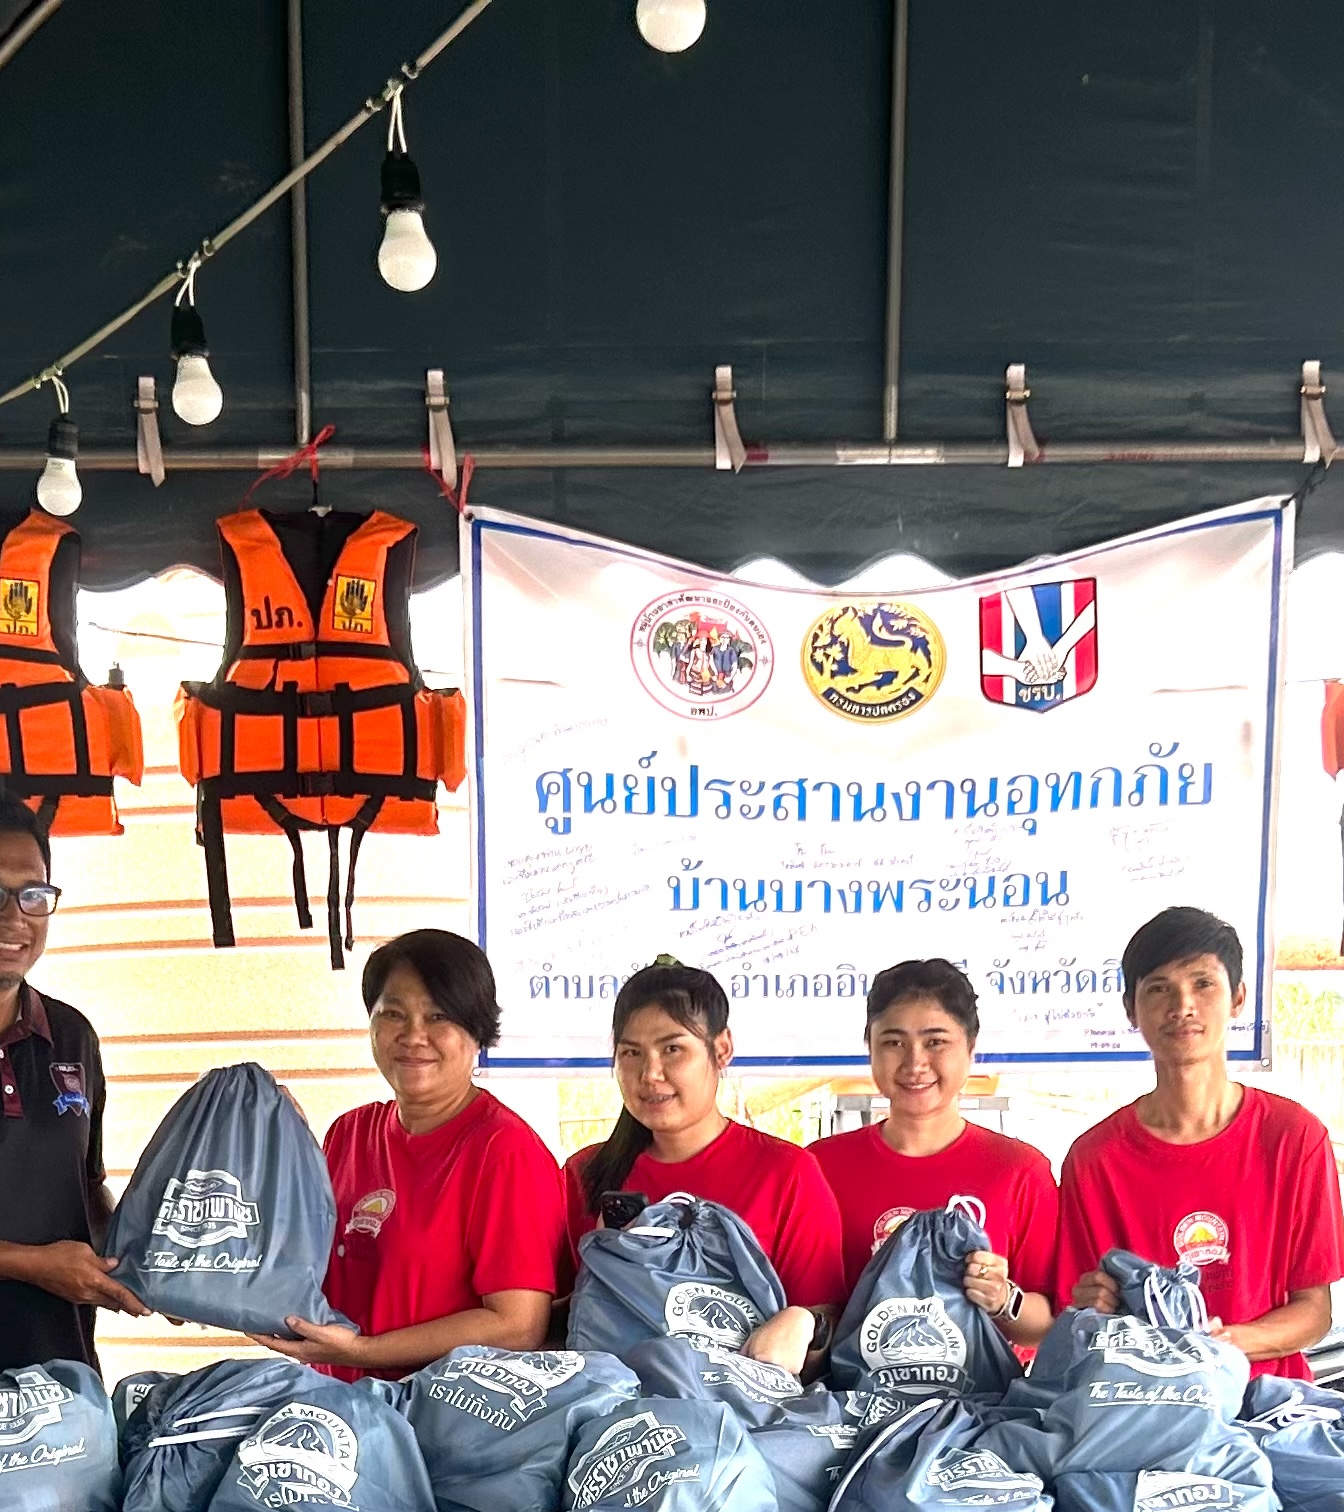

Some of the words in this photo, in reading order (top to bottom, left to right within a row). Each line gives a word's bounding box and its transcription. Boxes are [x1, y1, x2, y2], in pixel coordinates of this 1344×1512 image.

[251, 594, 303, 630] ปภ.
[828, 690, 917, 718] กรมการปกครอง
[1018, 685, 1062, 704] ชรบ.
[536, 742, 1214, 836] ศูนย์ประสานงานอุทกภัย
[667, 857, 1070, 914] บ้านบางพระนอน
[214, 1252, 263, 1274] Original
[866, 1304, 907, 1353] GOLDEN
[457, 1360, 540, 1396] ภูเขาทอง
[878, 1365, 959, 1388] ภูเขาทอง
[1089, 1381, 1110, 1399] The
[1114, 1382, 1143, 1400] Taste
[1144, 1384, 1163, 1405] of
[428, 1382, 518, 1432] เราไม่ทิ้งกัน
[9, 1447, 29, 1467] the
[30, 1436, 87, 1466] Original
[582, 1427, 678, 1506] ศรีราชาพานิช
[632, 1486, 649, 1504] the
[647, 1464, 701, 1492] Original
[825, 1465, 843, 1482] Th
